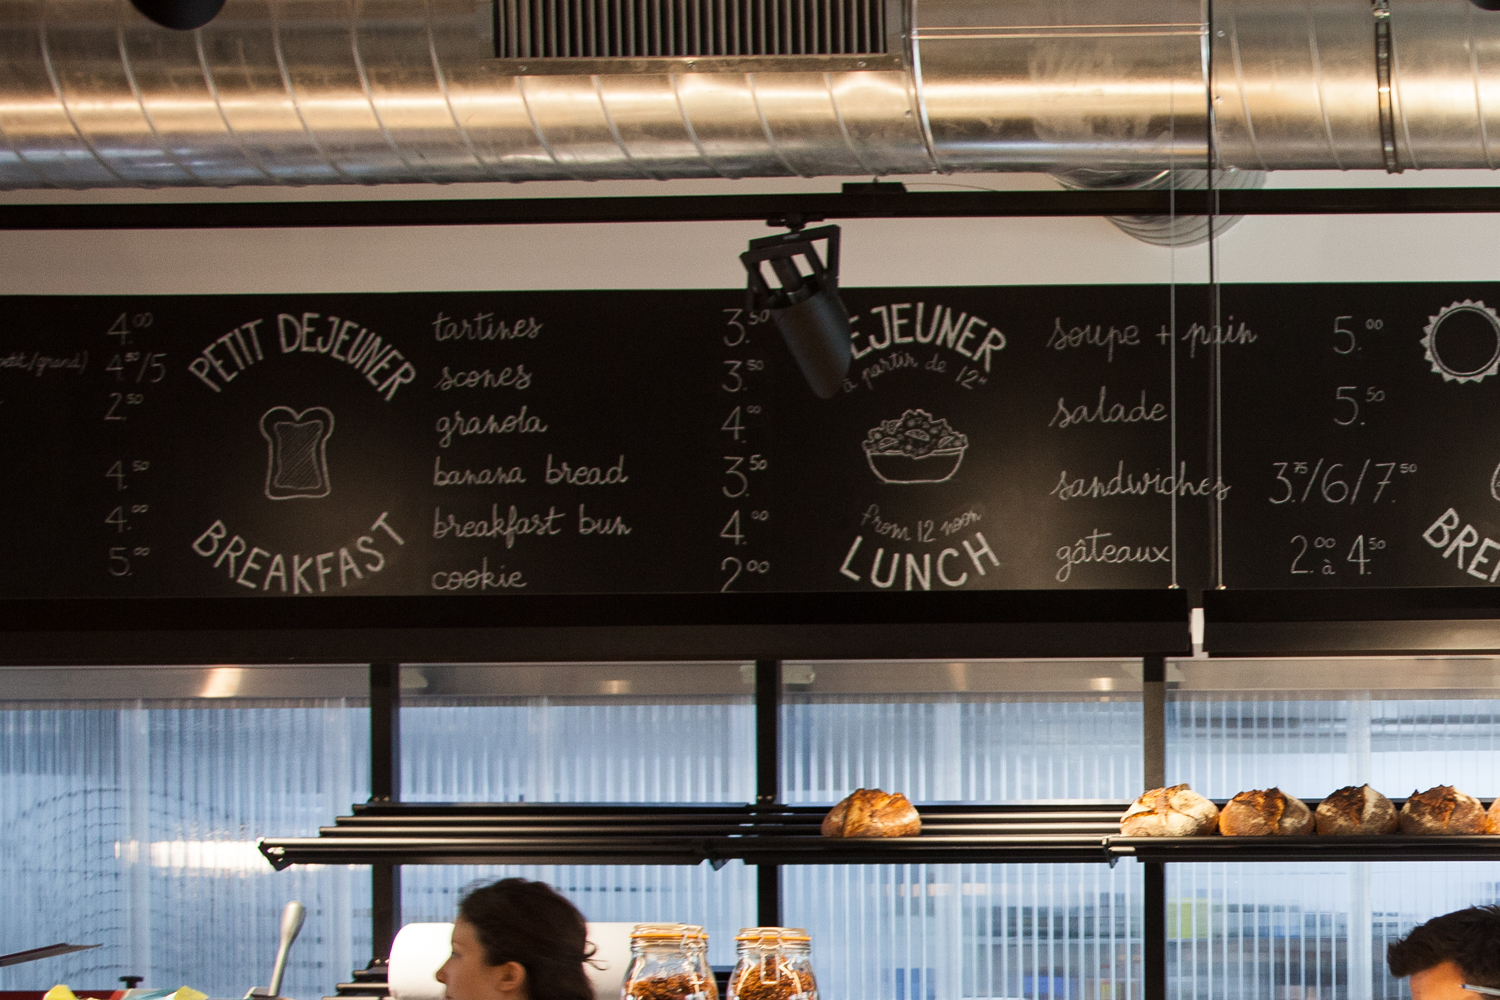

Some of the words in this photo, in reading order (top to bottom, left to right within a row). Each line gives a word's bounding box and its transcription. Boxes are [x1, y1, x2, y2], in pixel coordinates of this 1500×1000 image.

[431, 311, 544, 341] tartines
[848, 301, 1007, 374] EJEUNER
[1046, 317, 1141, 363] soupe
[1181, 316, 1259, 359] pain
[187, 318, 264, 393] PETIT
[277, 311, 417, 401] DEJEUNER
[433, 363, 533, 391] scones
[925, 353, 948, 374] de
[435, 404, 549, 448] granola
[1047, 385, 1168, 429] salade
[433, 455, 527, 487] banana
[545, 453, 629, 485] bread
[1049, 458, 1232, 501] sandwiches
[431, 502, 566, 550] breakfast
[578, 503, 632, 536] bun
[861, 503, 912, 543] from
[917, 519, 938, 543] 12
[191, 511, 405, 595] BREAKFAST
[431, 556, 528, 591] cookie
[840, 531, 1001, 591] LUNCH
[1055, 527, 1171, 583] gâteaux
